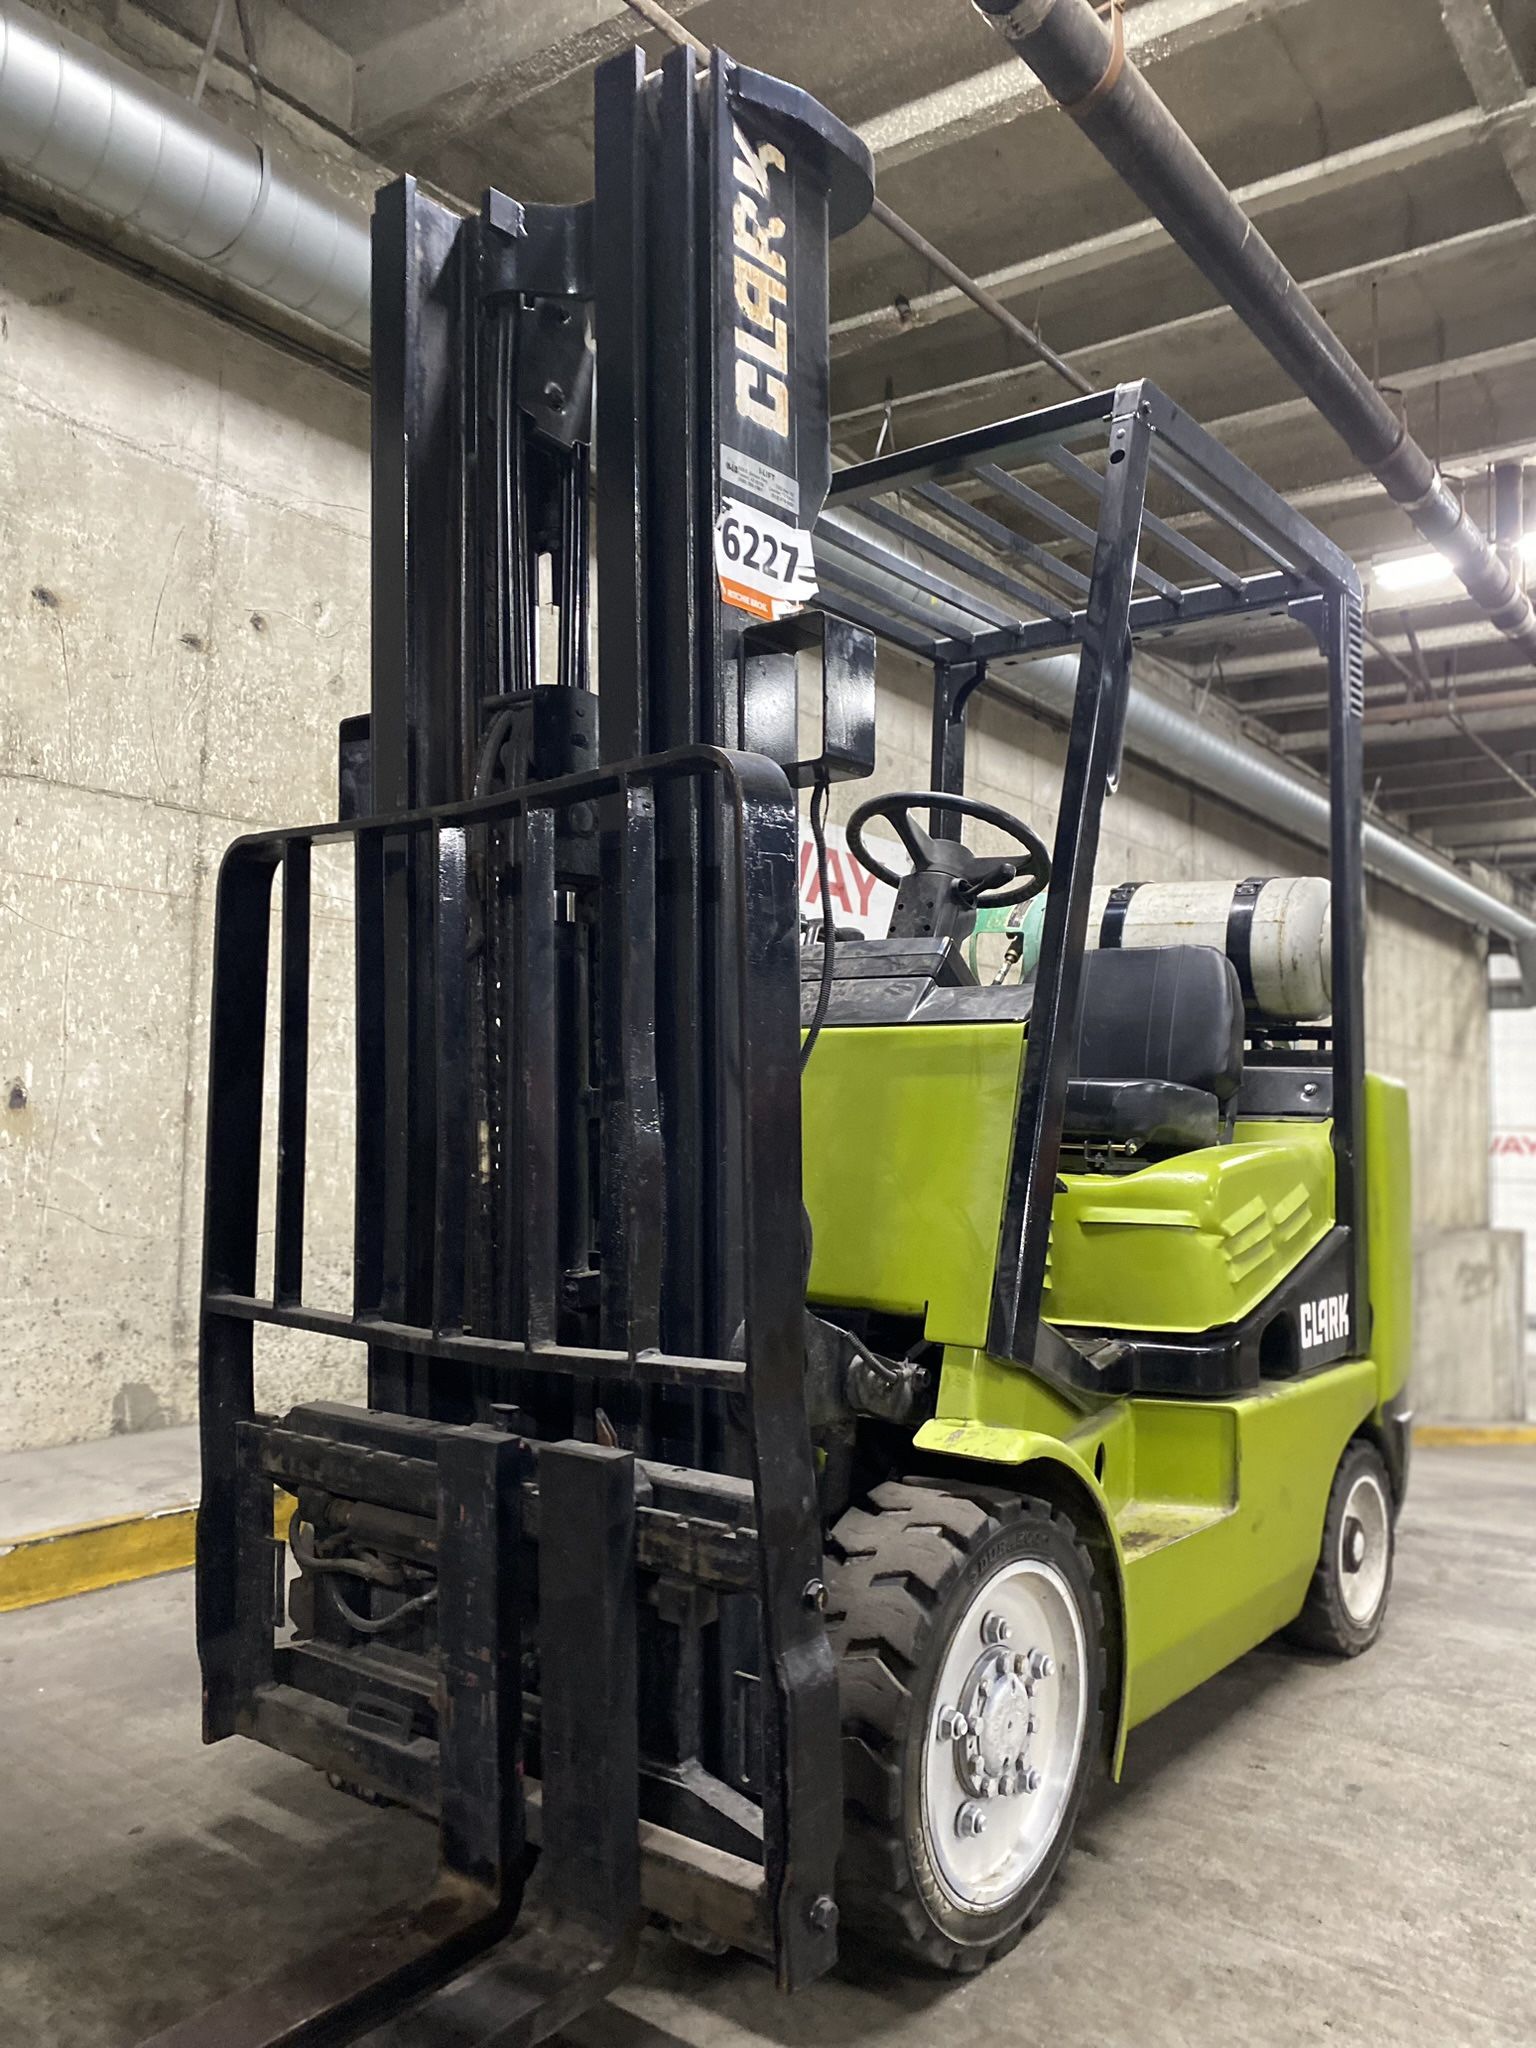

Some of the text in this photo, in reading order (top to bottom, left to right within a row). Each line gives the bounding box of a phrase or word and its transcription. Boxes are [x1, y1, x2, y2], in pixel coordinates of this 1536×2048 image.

[732, 122, 789, 438] CLARK
[722, 517, 799, 584] 6227
[1300, 1293, 1350, 1349] CLARK
